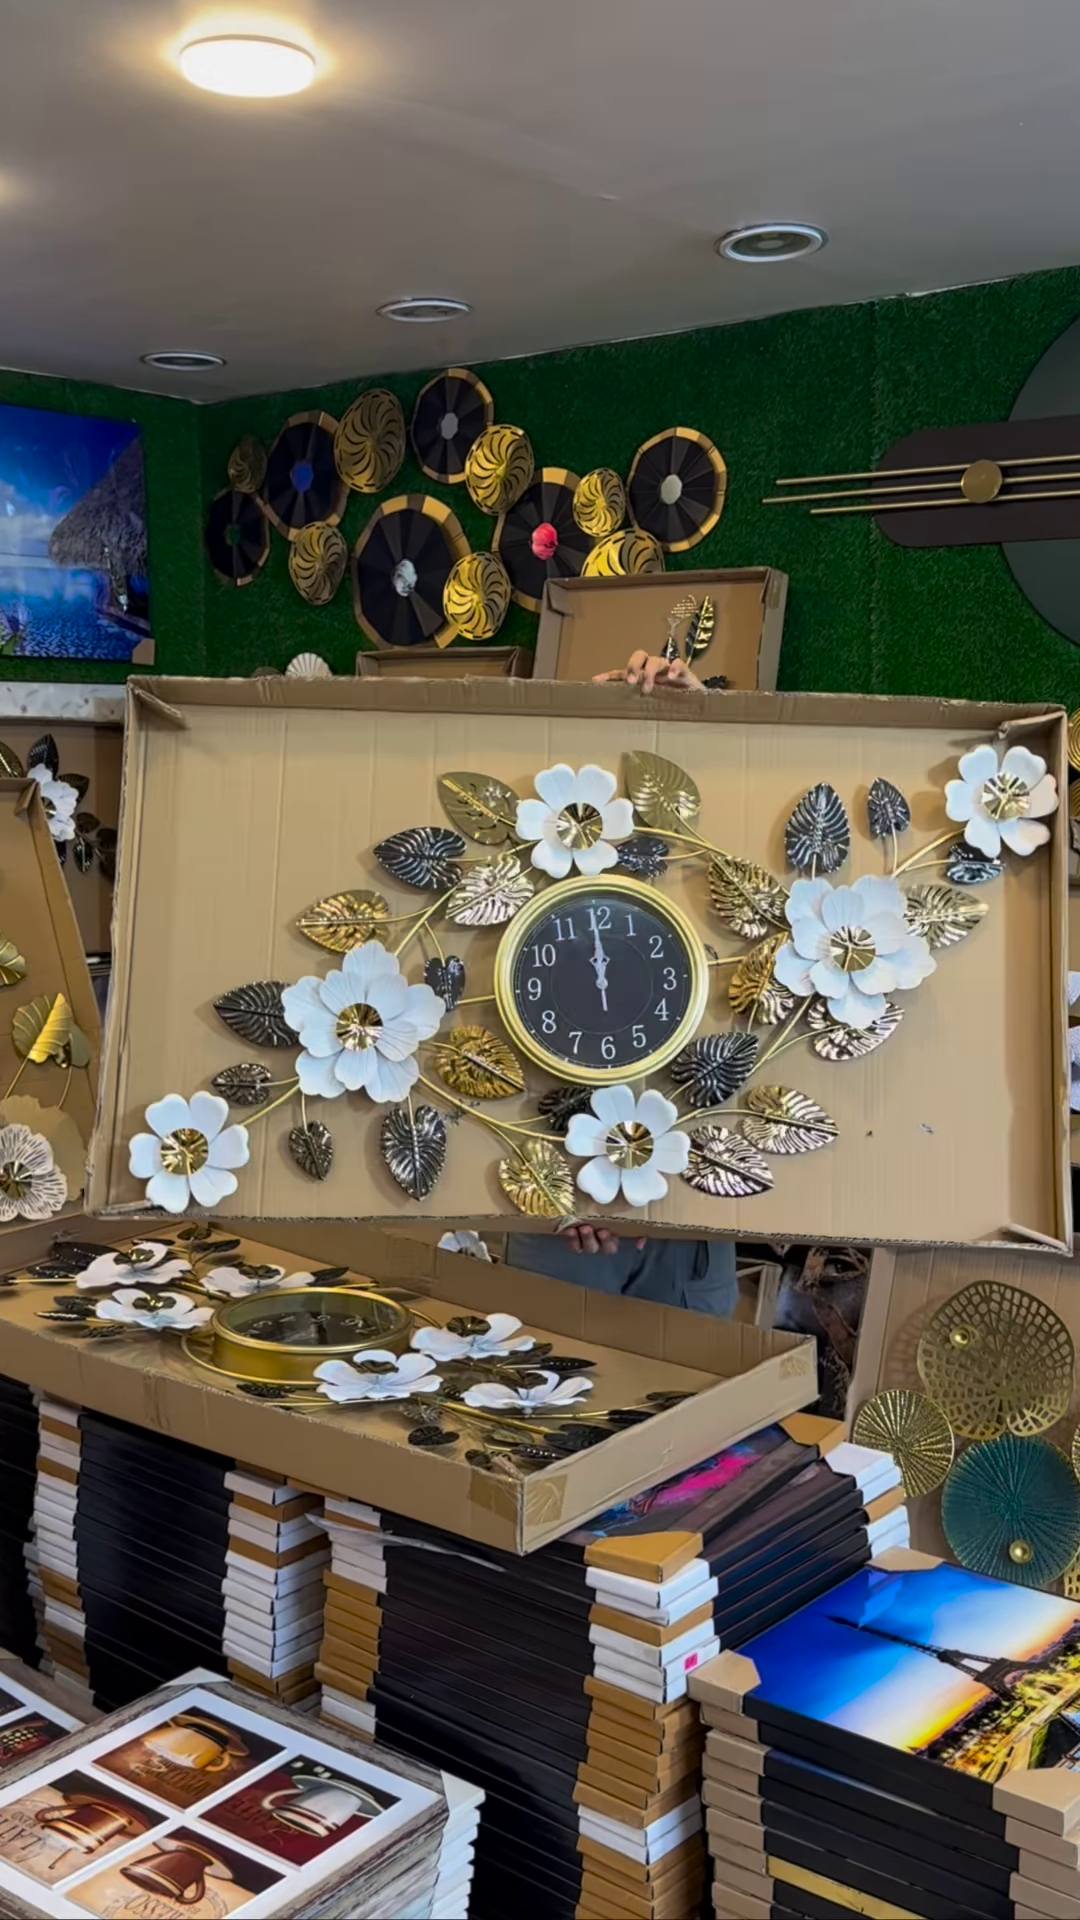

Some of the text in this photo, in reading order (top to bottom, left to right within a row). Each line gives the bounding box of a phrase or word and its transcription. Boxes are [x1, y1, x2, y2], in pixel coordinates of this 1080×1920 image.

[554, 917, 577, 941] 11
[587, 906, 612, 931] 12
[625, 914, 637, 937] 1
[532, 943, 556, 968] 10
[649, 935, 664, 959] 2
[527, 977, 542, 1001] 9
[663, 967, 677, 991] 3
[654, 997, 669, 1021] 4
[541, 1010, 557, 1034] 8
[568, 1031, 583, 1055] 7
[601, 1035, 616, 1060] 6
[632, 1024, 647, 1048] 5
